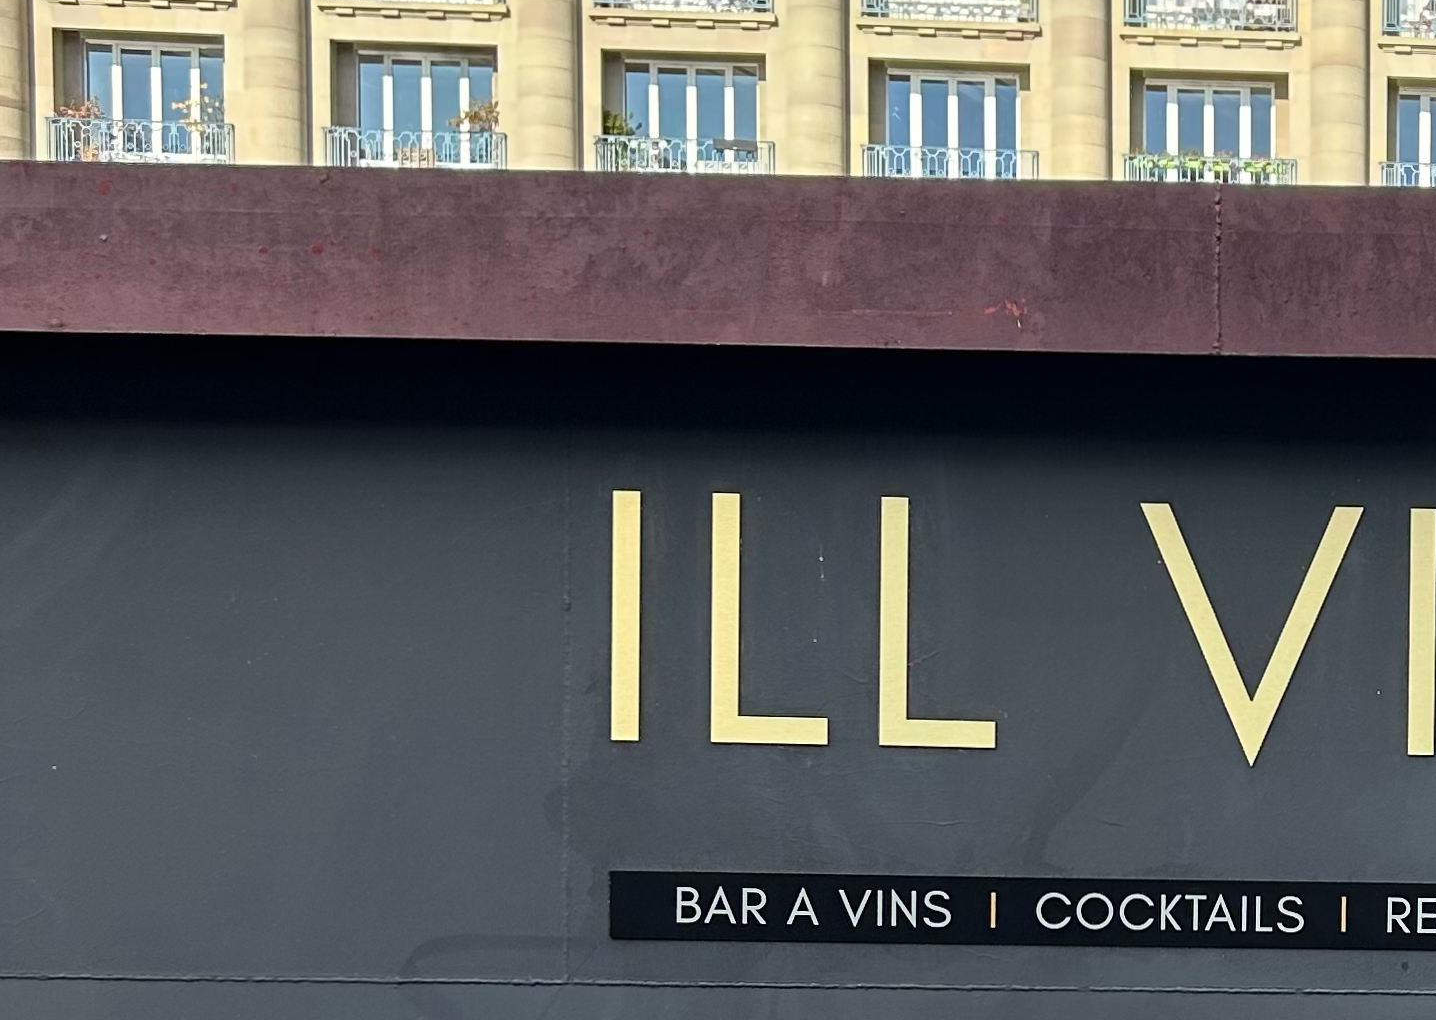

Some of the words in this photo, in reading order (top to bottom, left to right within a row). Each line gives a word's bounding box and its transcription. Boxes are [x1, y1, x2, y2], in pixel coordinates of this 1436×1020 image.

[610, 490, 994, 747] ILL
[675, 885, 767, 925] BAR
[786, 887, 819, 926] A
[838, 888, 953, 929] VINS
[1034, 891, 1306, 934] COCKTAILS
